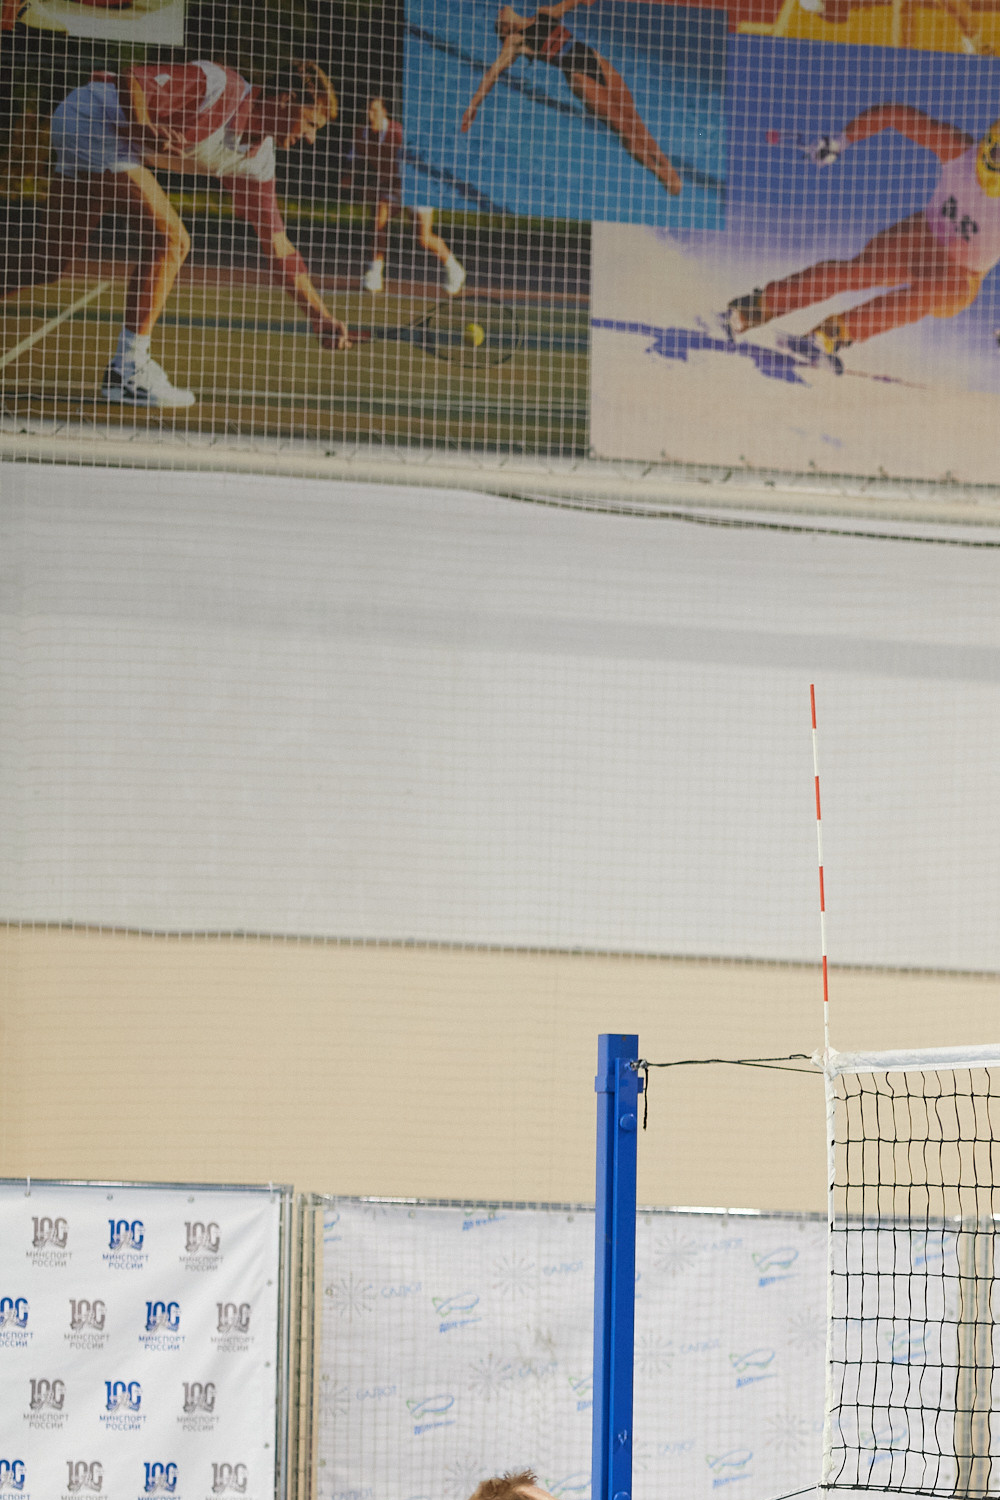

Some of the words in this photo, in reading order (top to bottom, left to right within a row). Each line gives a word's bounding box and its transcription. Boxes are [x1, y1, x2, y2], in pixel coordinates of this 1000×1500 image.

[26, 1251, 72, 1260] МИНСПОРТ
[102, 1254, 148, 1263] МИНСПОРТ
[179, 1255, 223, 1265] МИНСПОРТ
[32, 1259, 67, 1268] РОССИИ
[108, 1262, 143, 1271] РОССИИ
[185, 1264, 218, 1273] РОССИИ
[64, 1333, 110, 1342] МИНСПОРТ
[138, 1335, 185, 1344] МИНСПОРТ
[211, 1336, 254, 1345] МИНСПОРТ
[0, 1339, 27, 1348] ОССИИ
[70, 1341, 105, 1350] РОССИИ
[144, 1343, 180, 1352] РОССИИ
[217, 1344, 249, 1353] РОССИИ
[23, 1413, 68, 1422] МИНСПОРТ
[99, 1415, 146, 1424] МИНСПОРТ
[177, 1416, 219, 1425] МИНСПОРТ
[29, 1421, 63, 1430] РОССИИ
[105, 1423, 141, 1432] РОССИИ
[183, 1424, 214, 1433] РОССИИ
